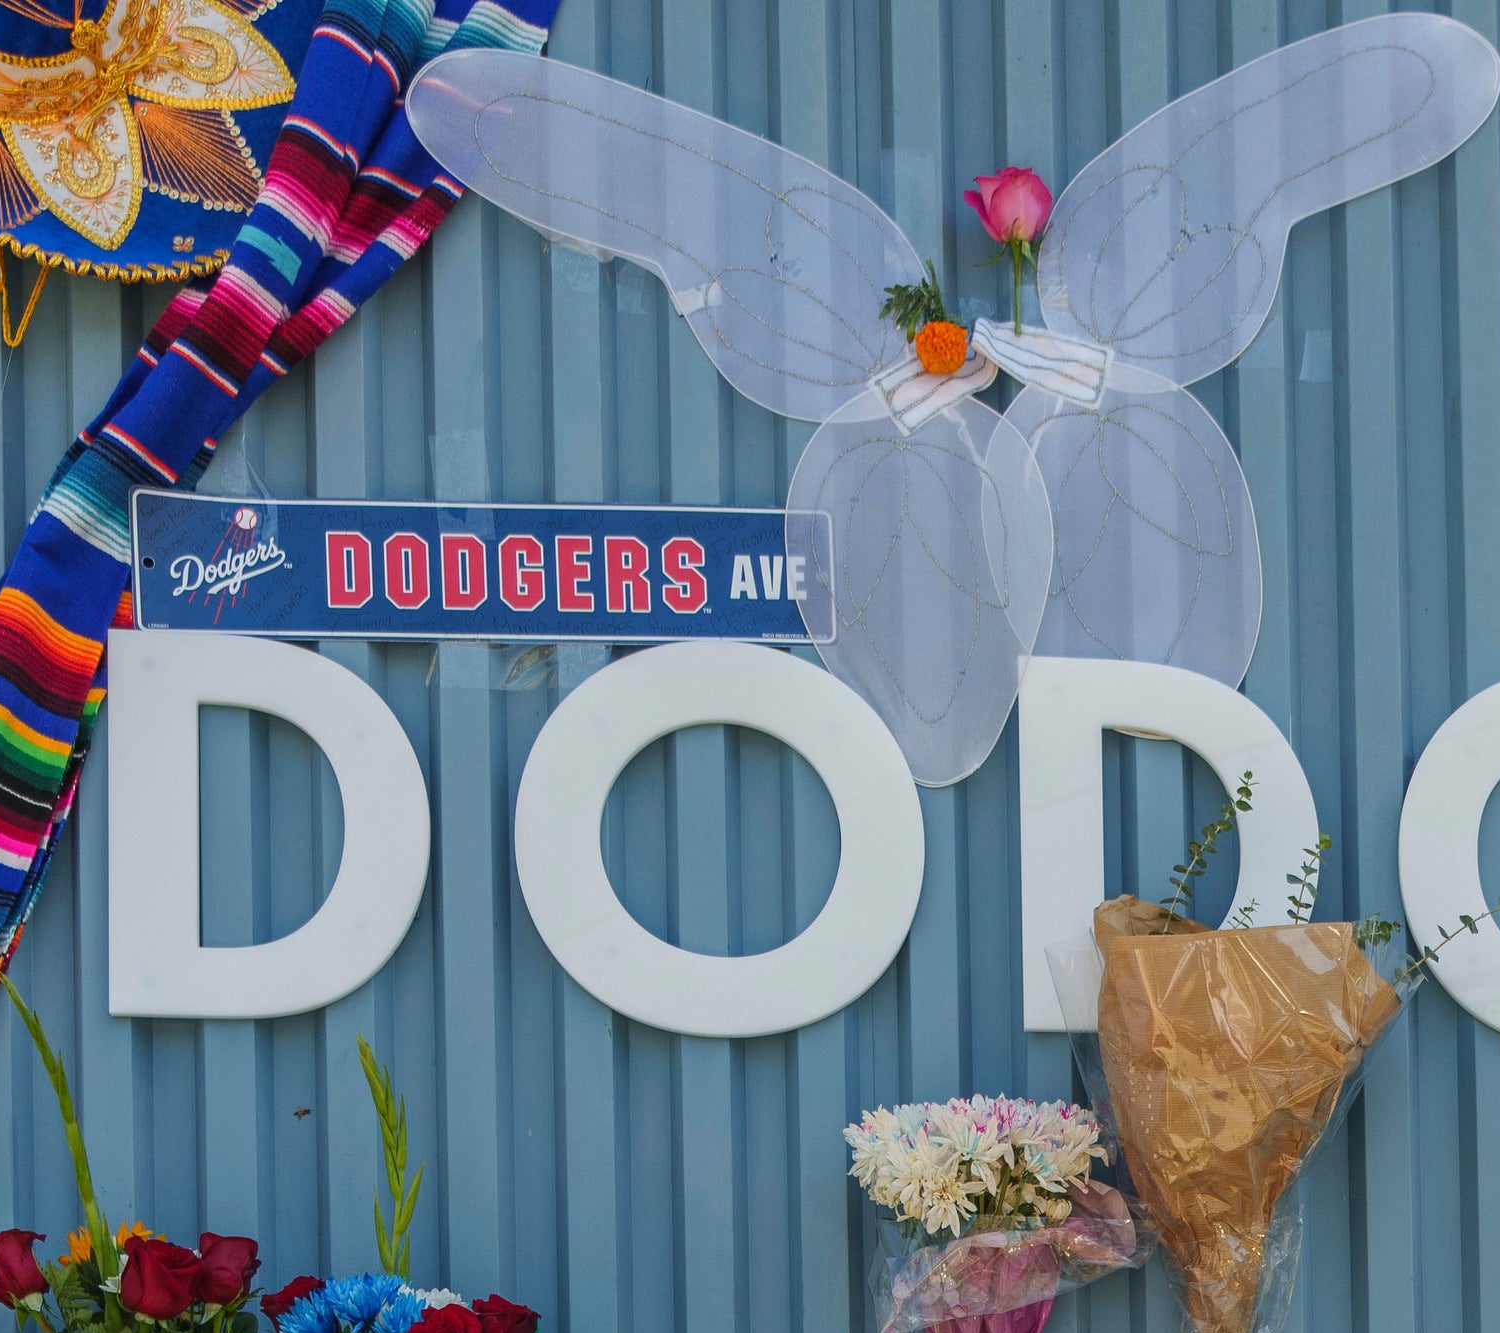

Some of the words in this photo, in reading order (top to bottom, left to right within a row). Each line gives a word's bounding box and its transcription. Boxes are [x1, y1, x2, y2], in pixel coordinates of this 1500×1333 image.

[169, 536, 286, 598] Dodgers
[325, 531, 708, 615] DODGERS
[730, 554, 808, 601] AVE
